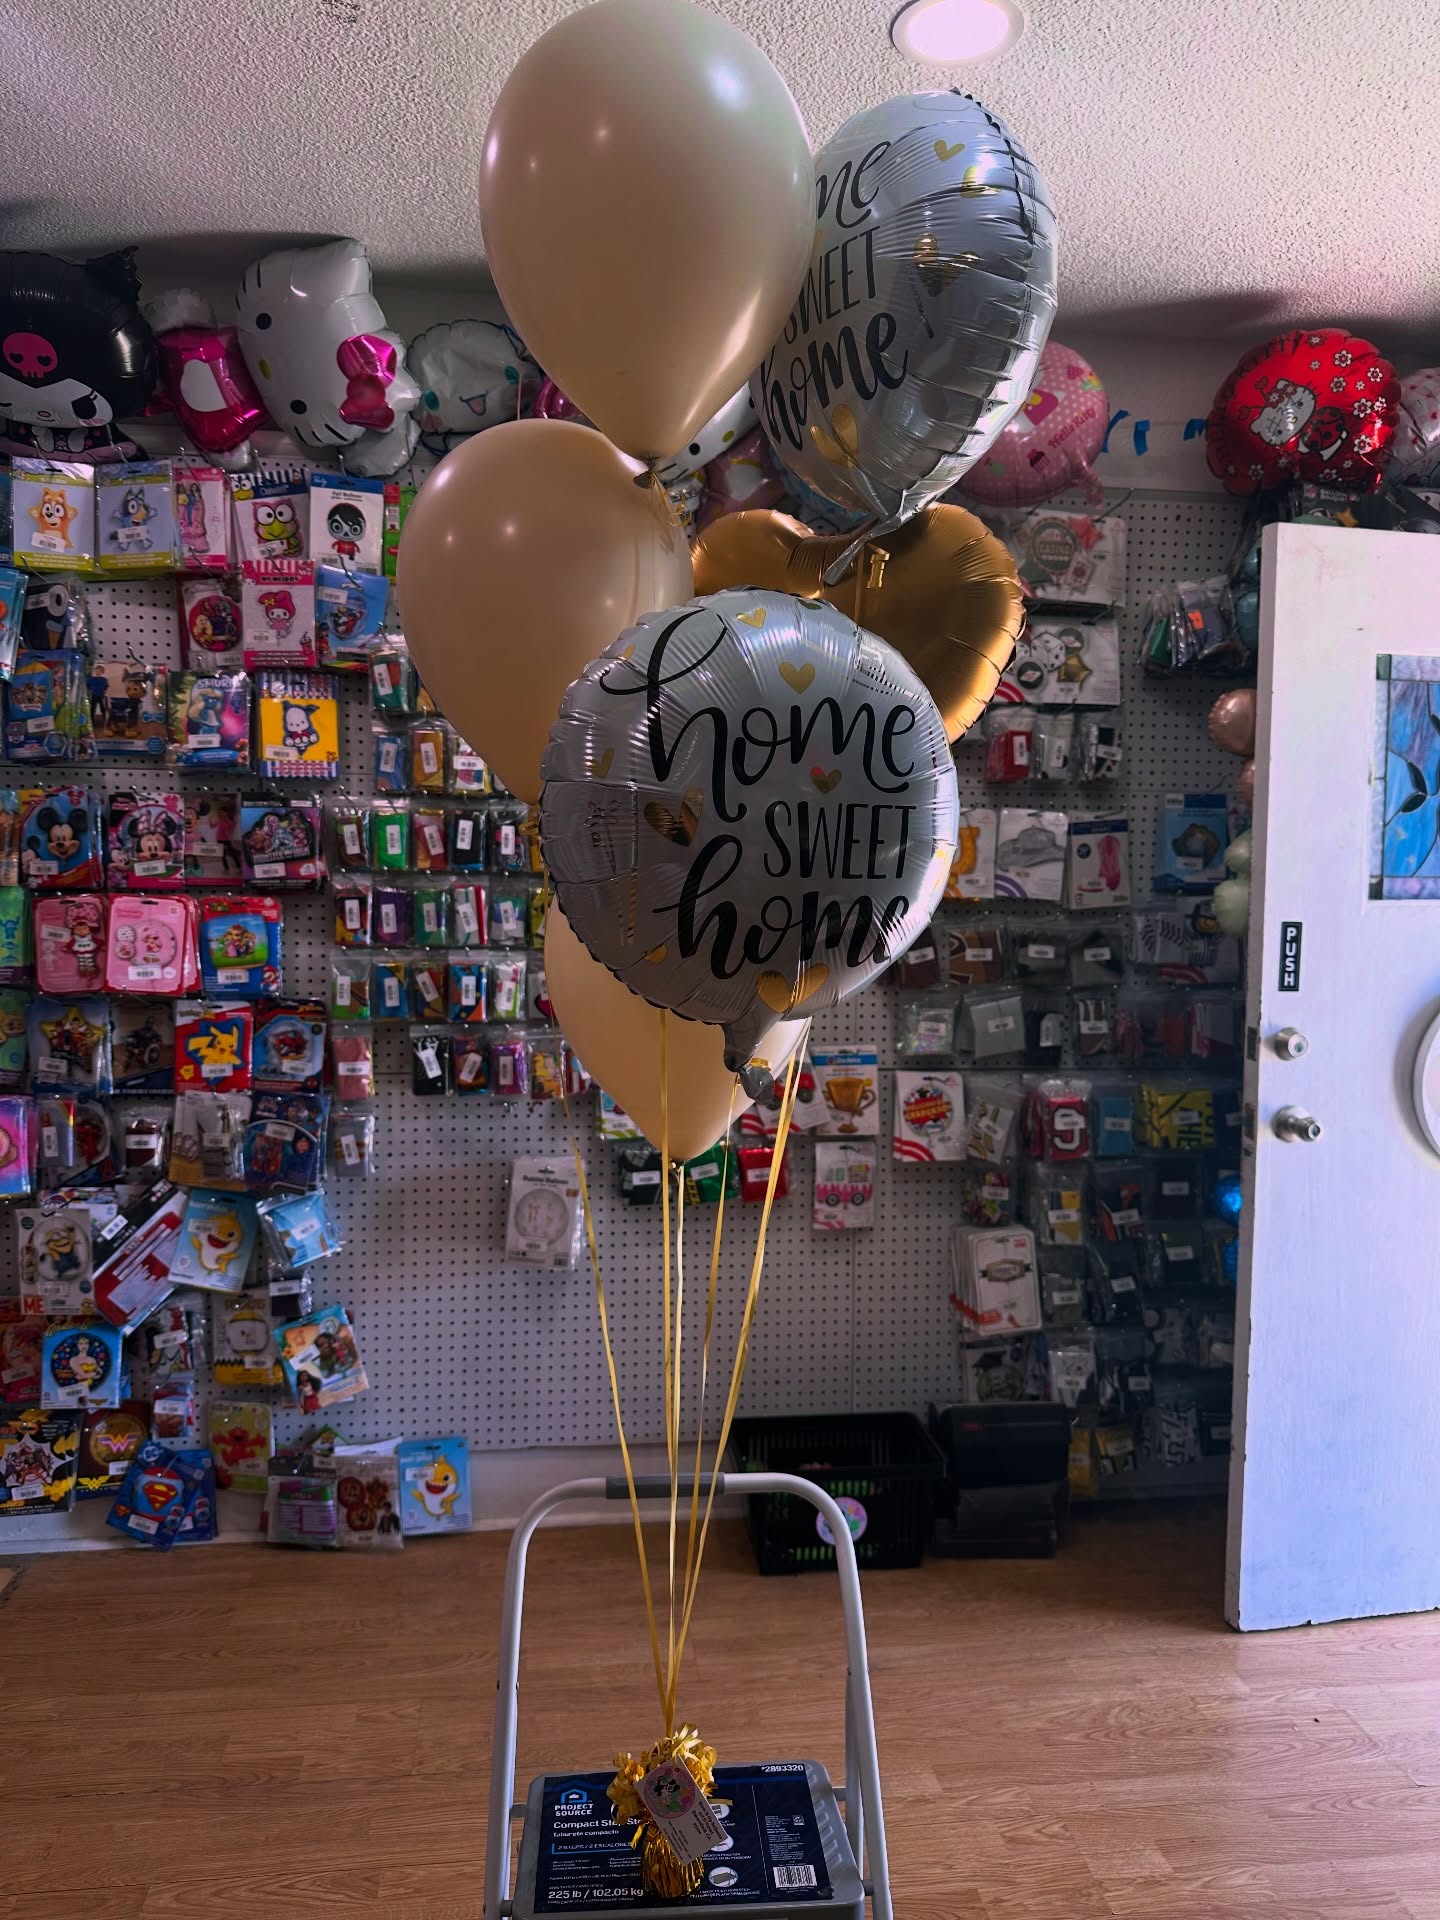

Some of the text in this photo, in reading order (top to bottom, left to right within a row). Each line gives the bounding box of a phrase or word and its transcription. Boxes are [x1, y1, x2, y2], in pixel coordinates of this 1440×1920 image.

[760, 312, 909, 451] home
[1048, 407, 1096, 448] Hello Kitty
[599, 607, 916, 823] home
[763, 799, 917, 879] SWEET
[652, 834, 910, 980] home
[1283, 926, 1297, 987] PUSH
[24, 1295, 45, 1314] ME
[553, 1819, 599, 1830] Compact
[601, 1819, 622, 1827] Ste
[554, 1803, 594, 1811] PROJECT
[555, 1809, 593, 1817] SOURCE
[548, 1887, 644, 1899] 225 lb / 102.05 kg
